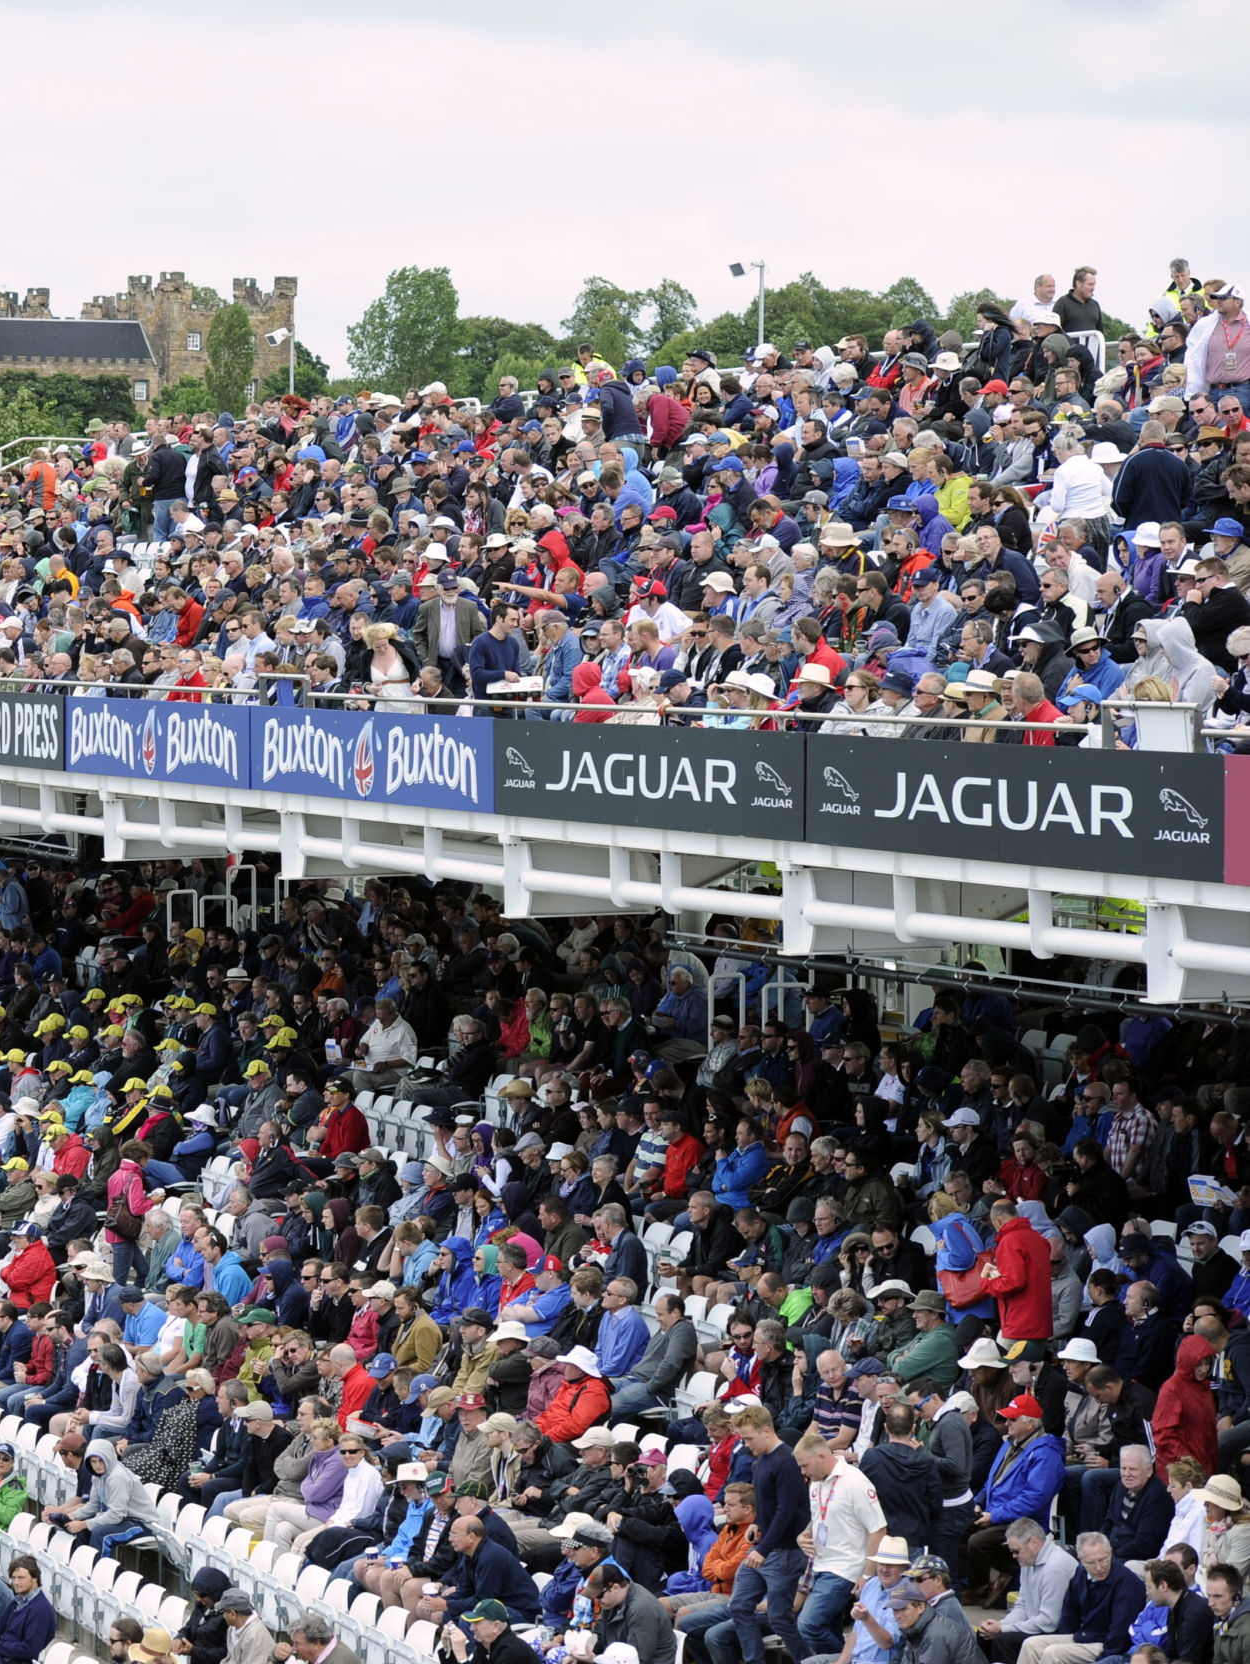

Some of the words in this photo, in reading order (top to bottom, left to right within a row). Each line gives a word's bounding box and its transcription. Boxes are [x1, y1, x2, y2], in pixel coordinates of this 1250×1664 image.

[14, 703, 58, 760] PRESS
[70, 703, 135, 771] Buxton
[166, 708, 238, 781] Buxton
[263, 714, 345, 791] Buxton
[386, 722, 478, 804] Buxton
[503, 779, 536, 790] JAGUAR
[546, 750, 737, 804] JAGUAR
[751, 797, 793, 810] JAGUAR
[819, 803, 862, 817] JAGUAR
[874, 772, 1134, 838] JAGUAR
[1154, 830, 1210, 845] JAGUAR
